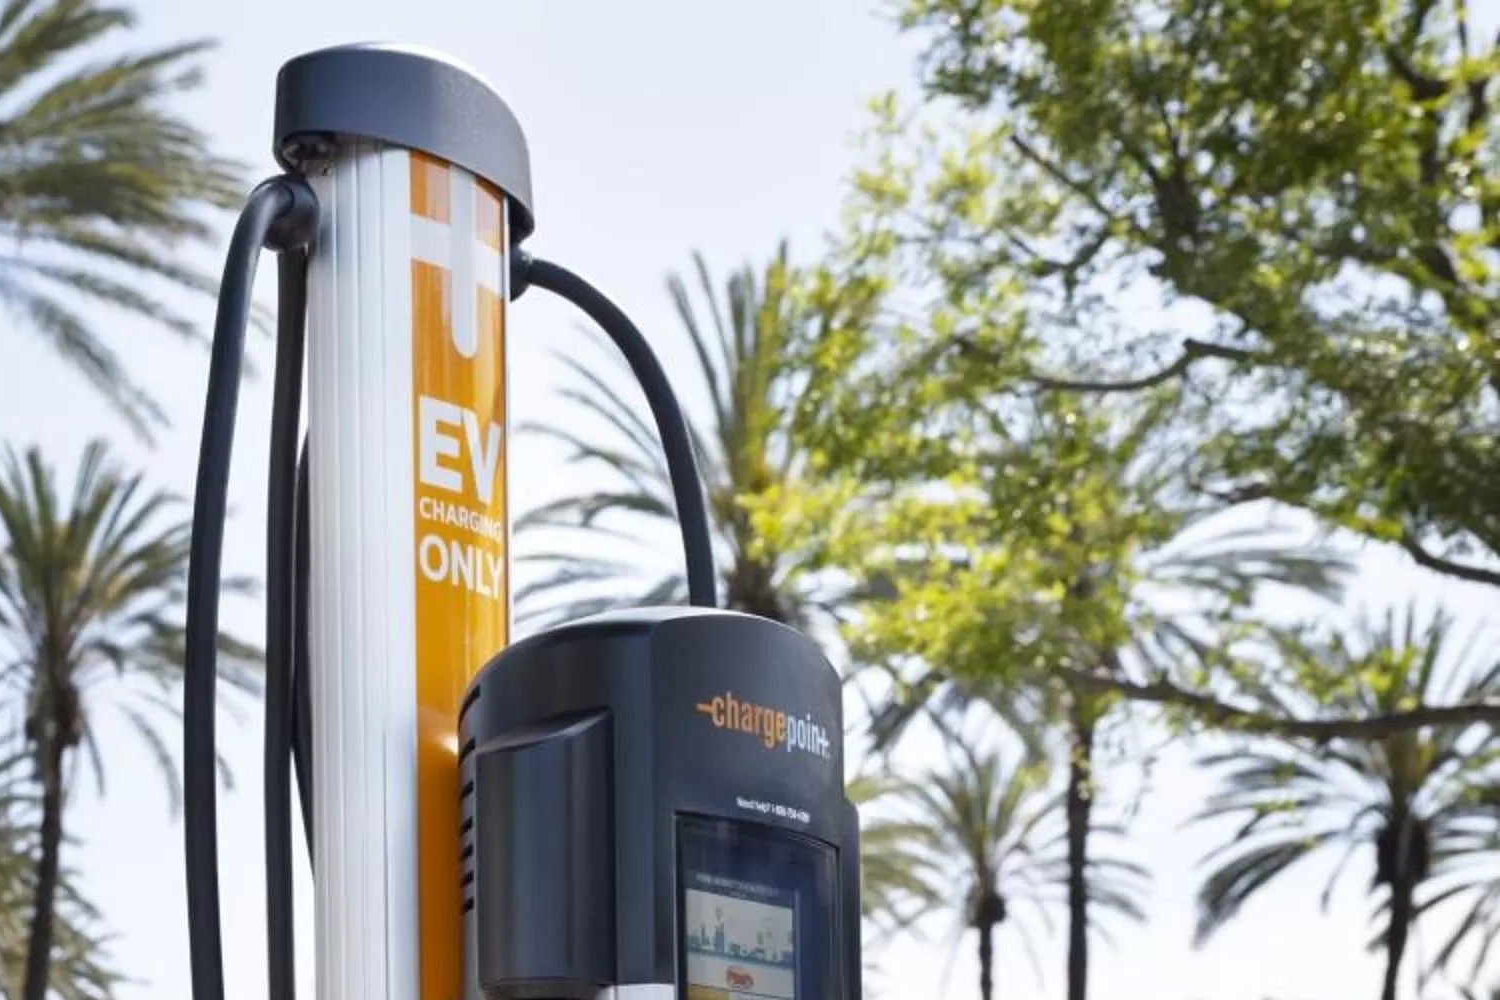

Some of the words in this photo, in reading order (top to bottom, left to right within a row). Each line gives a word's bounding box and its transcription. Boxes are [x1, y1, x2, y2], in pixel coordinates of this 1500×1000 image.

[419, 395, 501, 505] EV
[419, 496, 503, 543] CHARGING
[419, 534, 504, 600] ONLY
